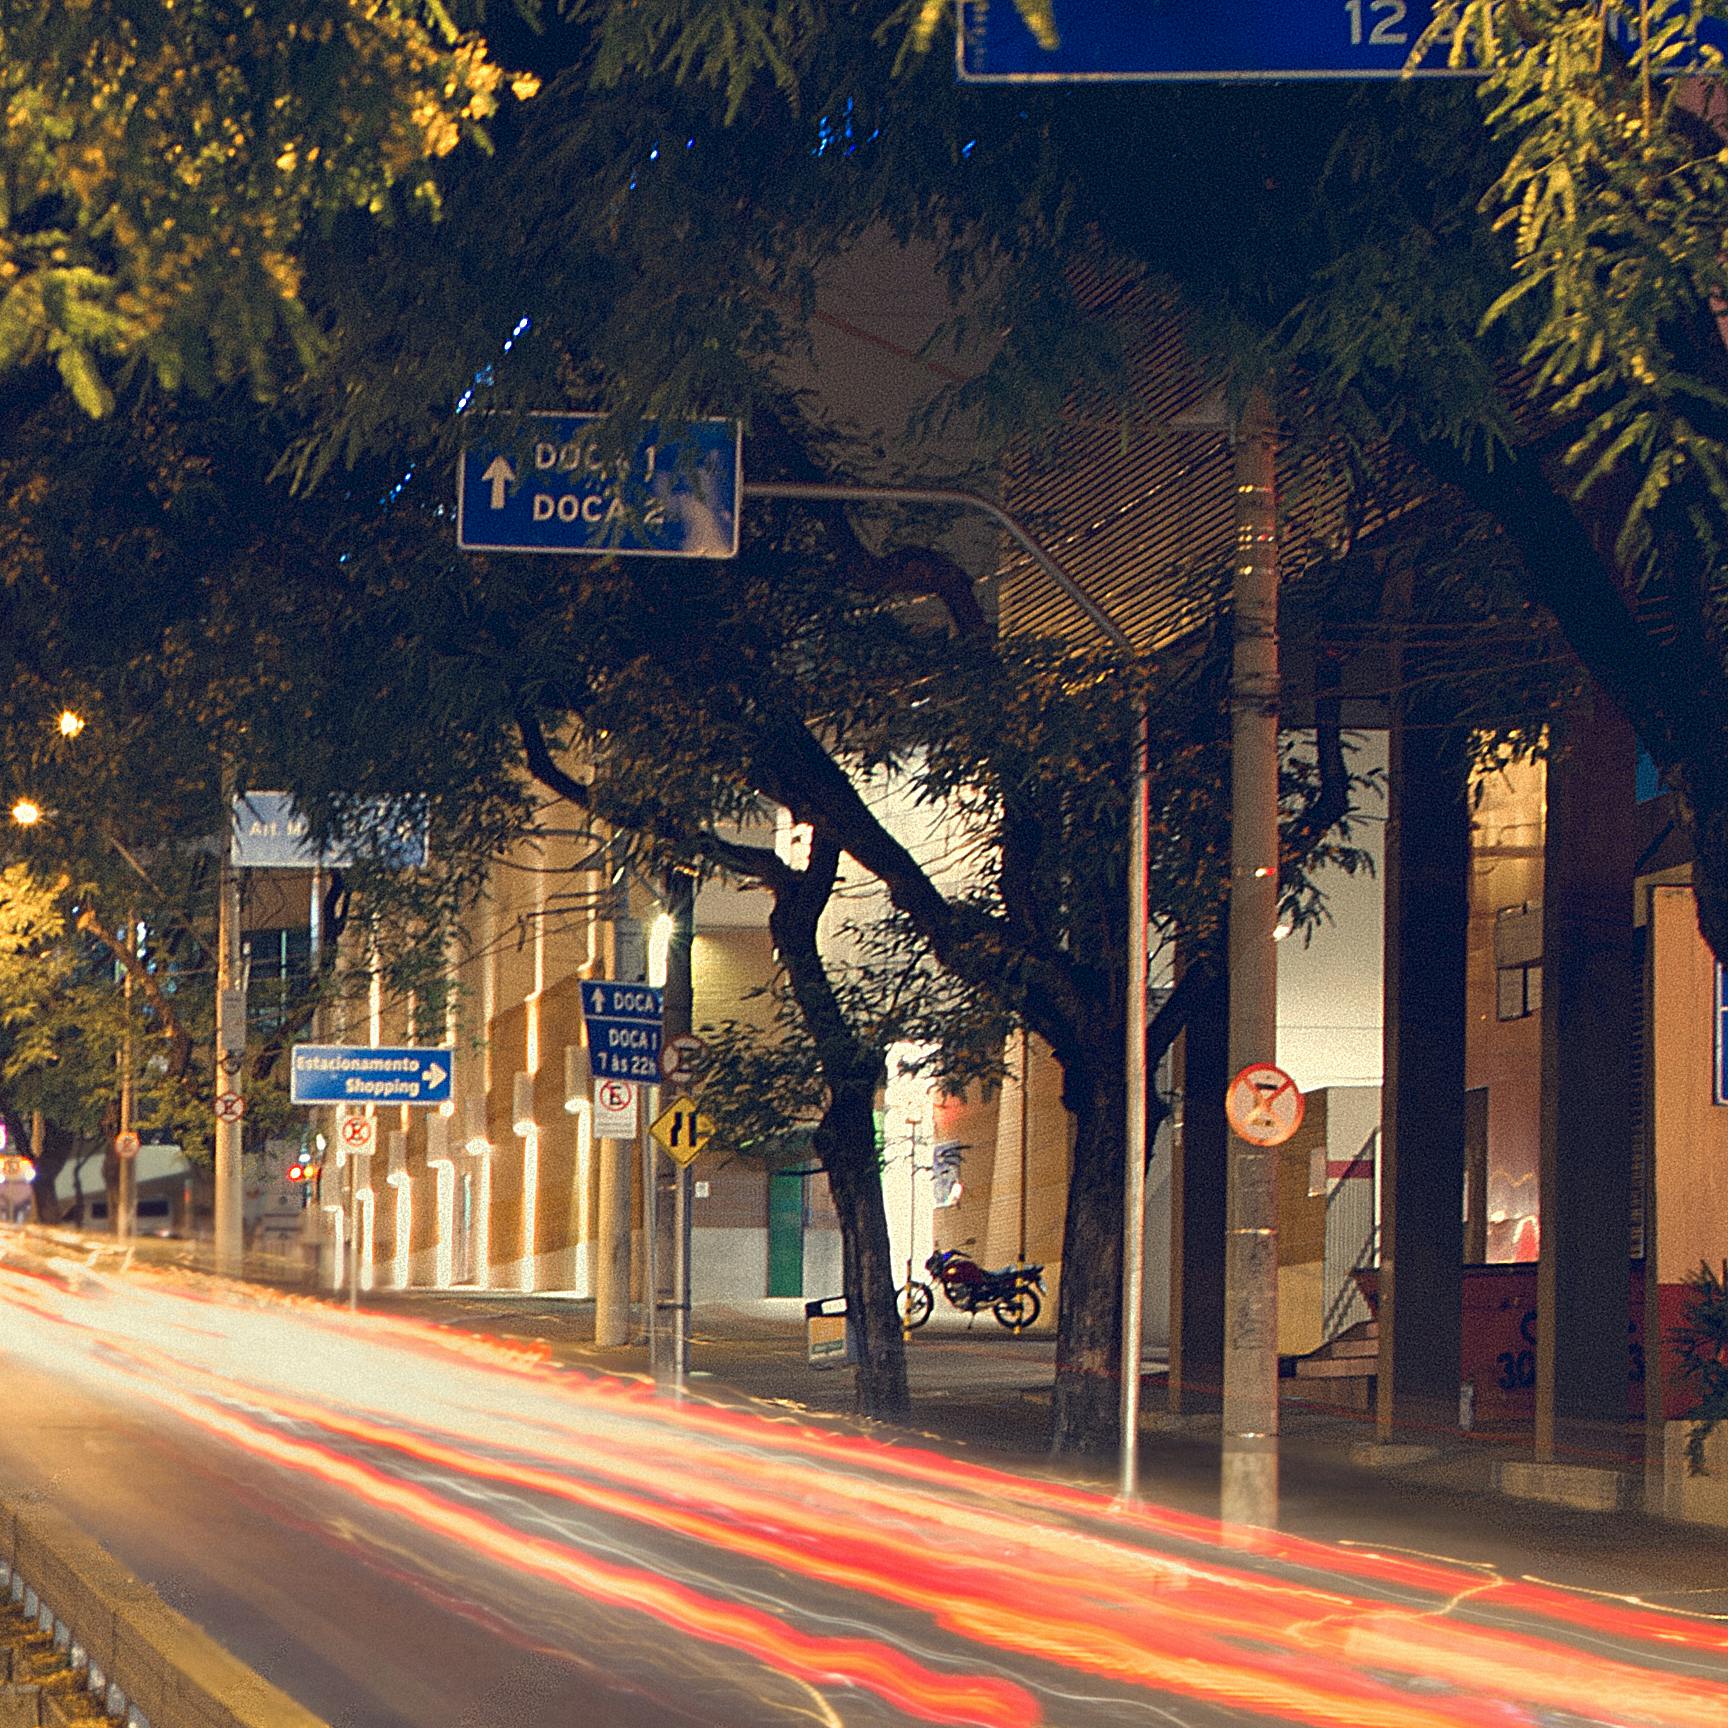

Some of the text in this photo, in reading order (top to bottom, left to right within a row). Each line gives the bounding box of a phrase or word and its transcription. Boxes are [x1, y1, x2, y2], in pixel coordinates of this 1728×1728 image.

[1344, 0, 1408, 46] 12
[532, 493, 626, 522] DOCA
[613, 991, 655, 1013] DOCA
[608, 1027, 648, 1050] DOCA
[296, 1054, 421, 1072] Estacionamento
[597, 1052, 608, 1071] 7
[345, 1077, 420, 1098] Shopping
